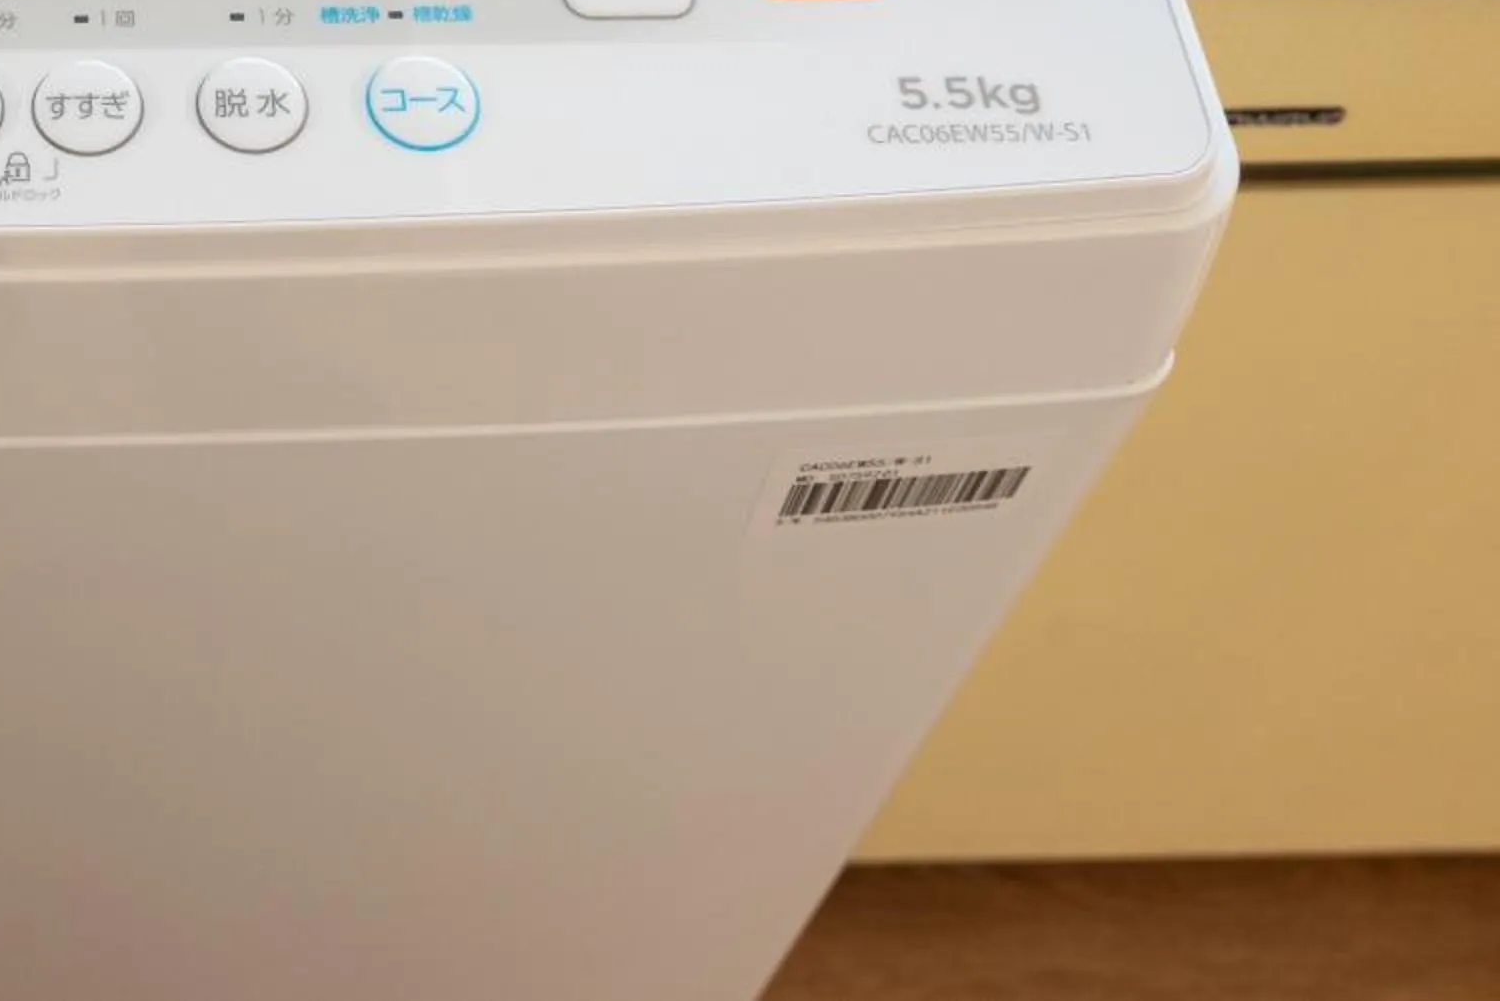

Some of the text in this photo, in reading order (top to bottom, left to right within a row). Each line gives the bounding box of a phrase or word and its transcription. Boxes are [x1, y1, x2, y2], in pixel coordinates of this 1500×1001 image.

[45, 91, 130, 120] すすぎ
[214, 89, 291, 118] 脱水
[381, 87, 466, 114] コース
[898, 75, 1042, 113] 5.5kg
[867, 121, 1092, 145] CAC06EW55/W-S1
